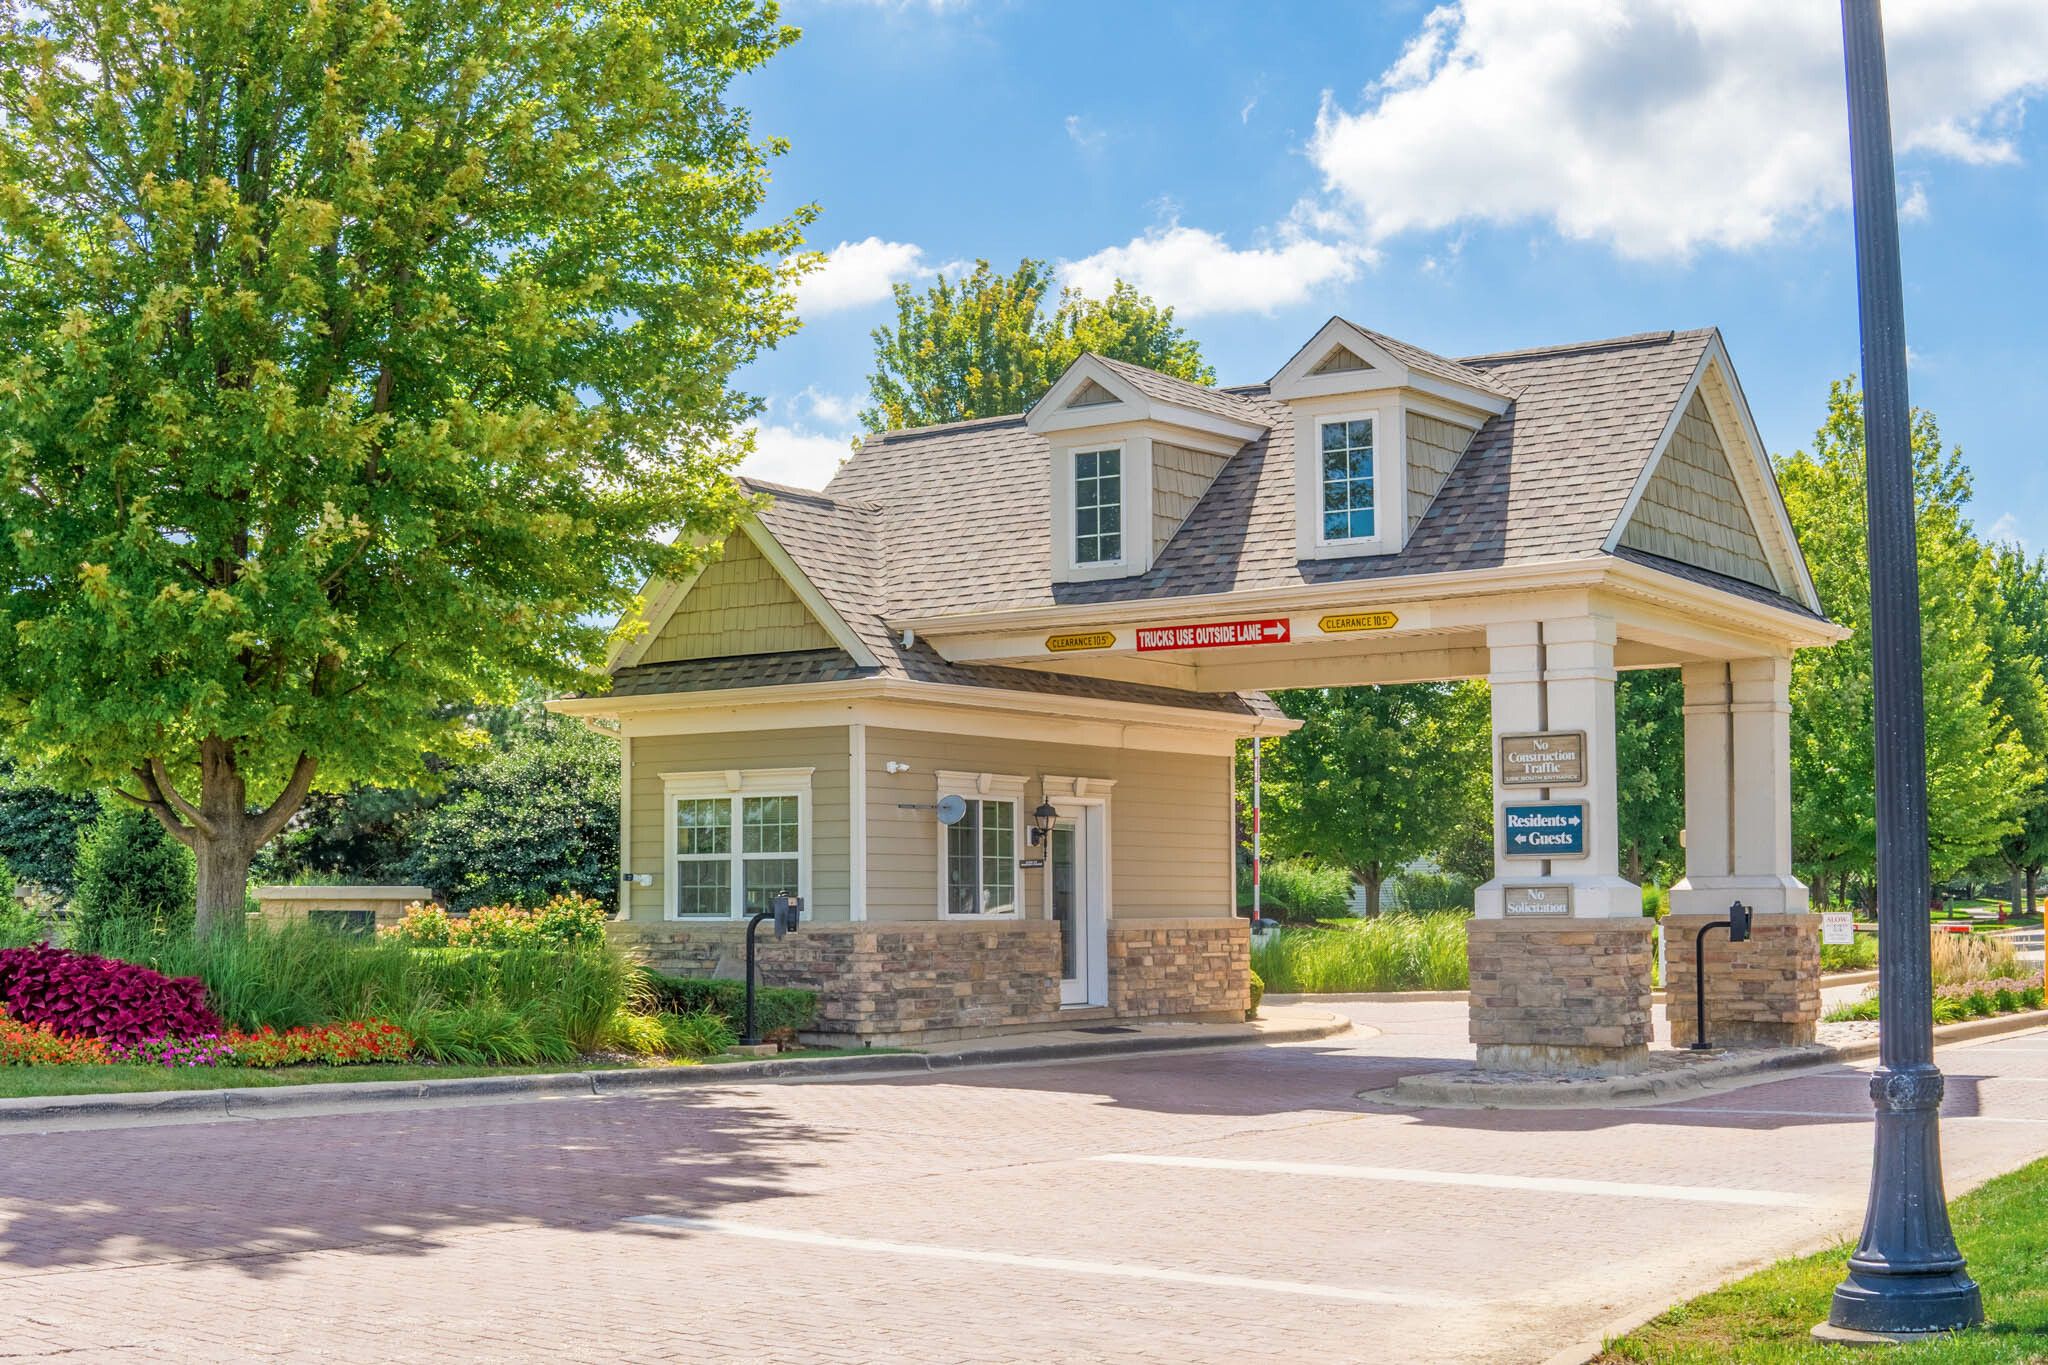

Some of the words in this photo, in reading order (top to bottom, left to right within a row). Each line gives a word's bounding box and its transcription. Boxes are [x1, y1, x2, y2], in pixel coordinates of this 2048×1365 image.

[1326, 617, 1371, 629] CLEARANCE
[1052, 636, 1094, 648] CLEARANCE
[1139, 630, 1174, 648] TRUCKS
[1176, 628, 1195, 646] USE
[1196, 625, 1235, 644] OUTSIDE
[1237, 624, 1262, 641] LANE
[1533, 739, 1549, 751] No
[1508, 750, 1576, 763] Construction
[1523, 762, 1561, 774] Traffic
[1507, 814, 1567, 828] Residents
[1528, 832, 1573, 846] Guests
[1528, 888, 1545, 900] No
[1507, 901, 1567, 913] Solicitation
